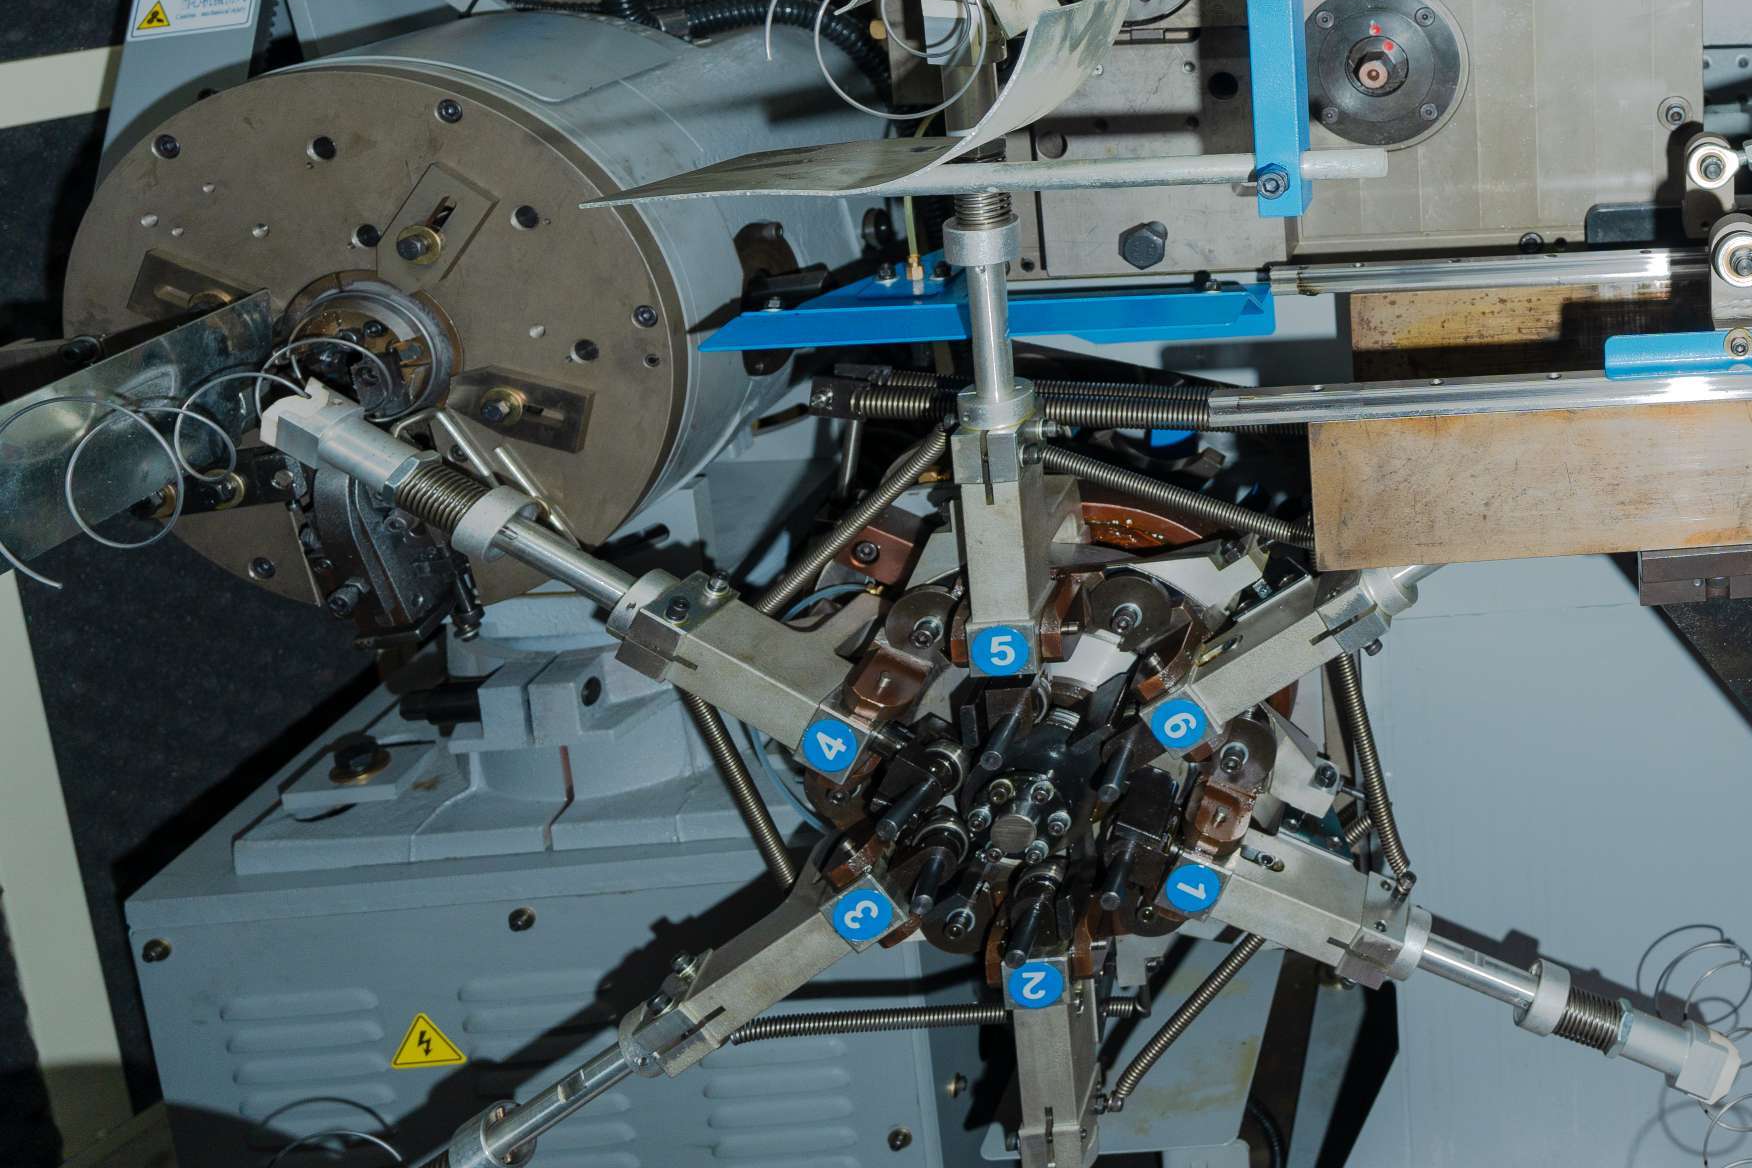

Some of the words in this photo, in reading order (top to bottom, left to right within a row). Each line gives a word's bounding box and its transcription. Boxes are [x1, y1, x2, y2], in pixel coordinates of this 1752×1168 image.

[990, 636, 1015, 666] 5
[1163, 711, 1197, 740] 6
[817, 731, 848, 760] 4
[1177, 876, 1207, 901] 1
[844, 899, 879, 930] 3
[1022, 971, 1048, 1000] 2
